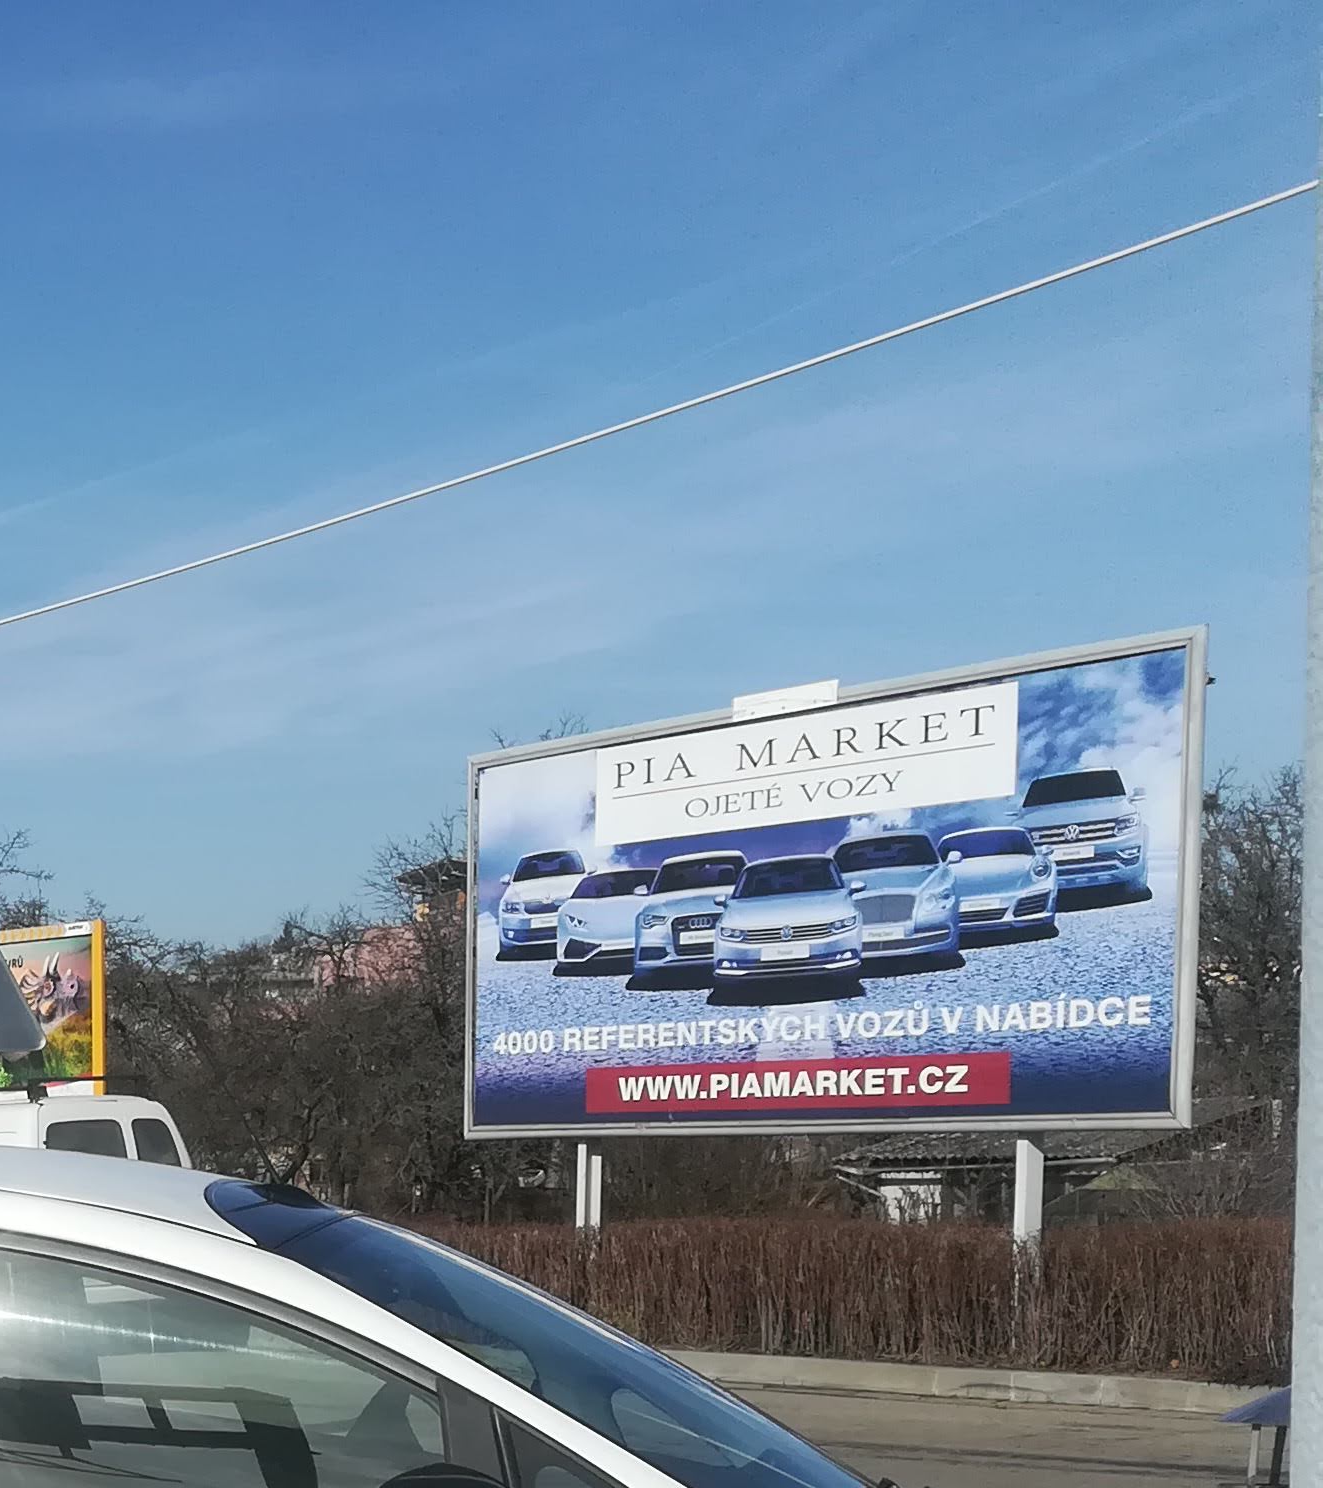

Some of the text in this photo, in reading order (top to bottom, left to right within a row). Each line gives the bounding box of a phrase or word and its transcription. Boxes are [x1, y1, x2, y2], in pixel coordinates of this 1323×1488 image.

[613, 703, 997, 789] PIA MARKET
[684, 769, 904, 819] OJETÉ VOZY
[493, 1028, 556, 1056] 4000
[837, 1000, 930, 1039] VOZŮ
[940, 1007, 961, 1033] V
[976, 993, 1152, 1031] NABÍDCE
[618, 1065, 969, 1102] WWW.PIAMARKET.CZ
